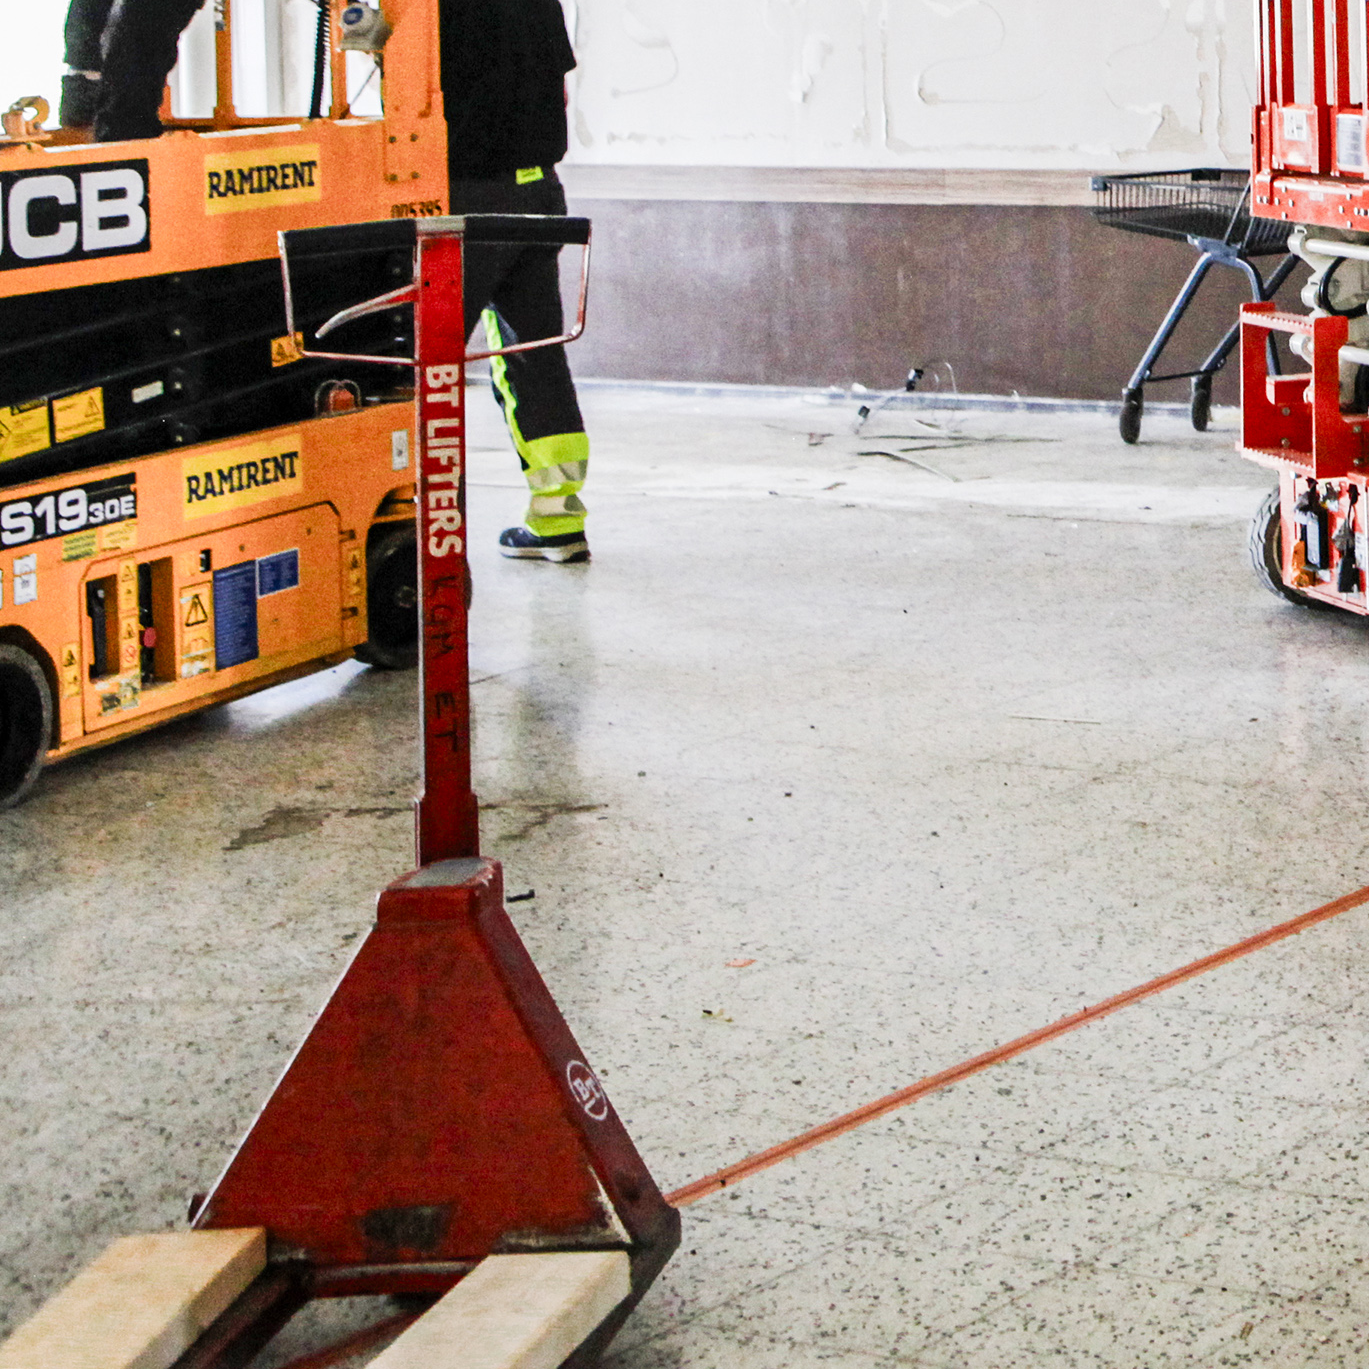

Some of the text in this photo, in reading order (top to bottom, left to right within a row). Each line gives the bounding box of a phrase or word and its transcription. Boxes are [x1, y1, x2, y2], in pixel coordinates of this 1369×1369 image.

[207, 160, 317, 199] RAMIRENT
[0, 169, 148, 260] CB
[186, 450, 299, 504] RAMIRENT
[426, 363, 464, 559] BT LIFTERS
[572, 1076, 602, 1102] BT
